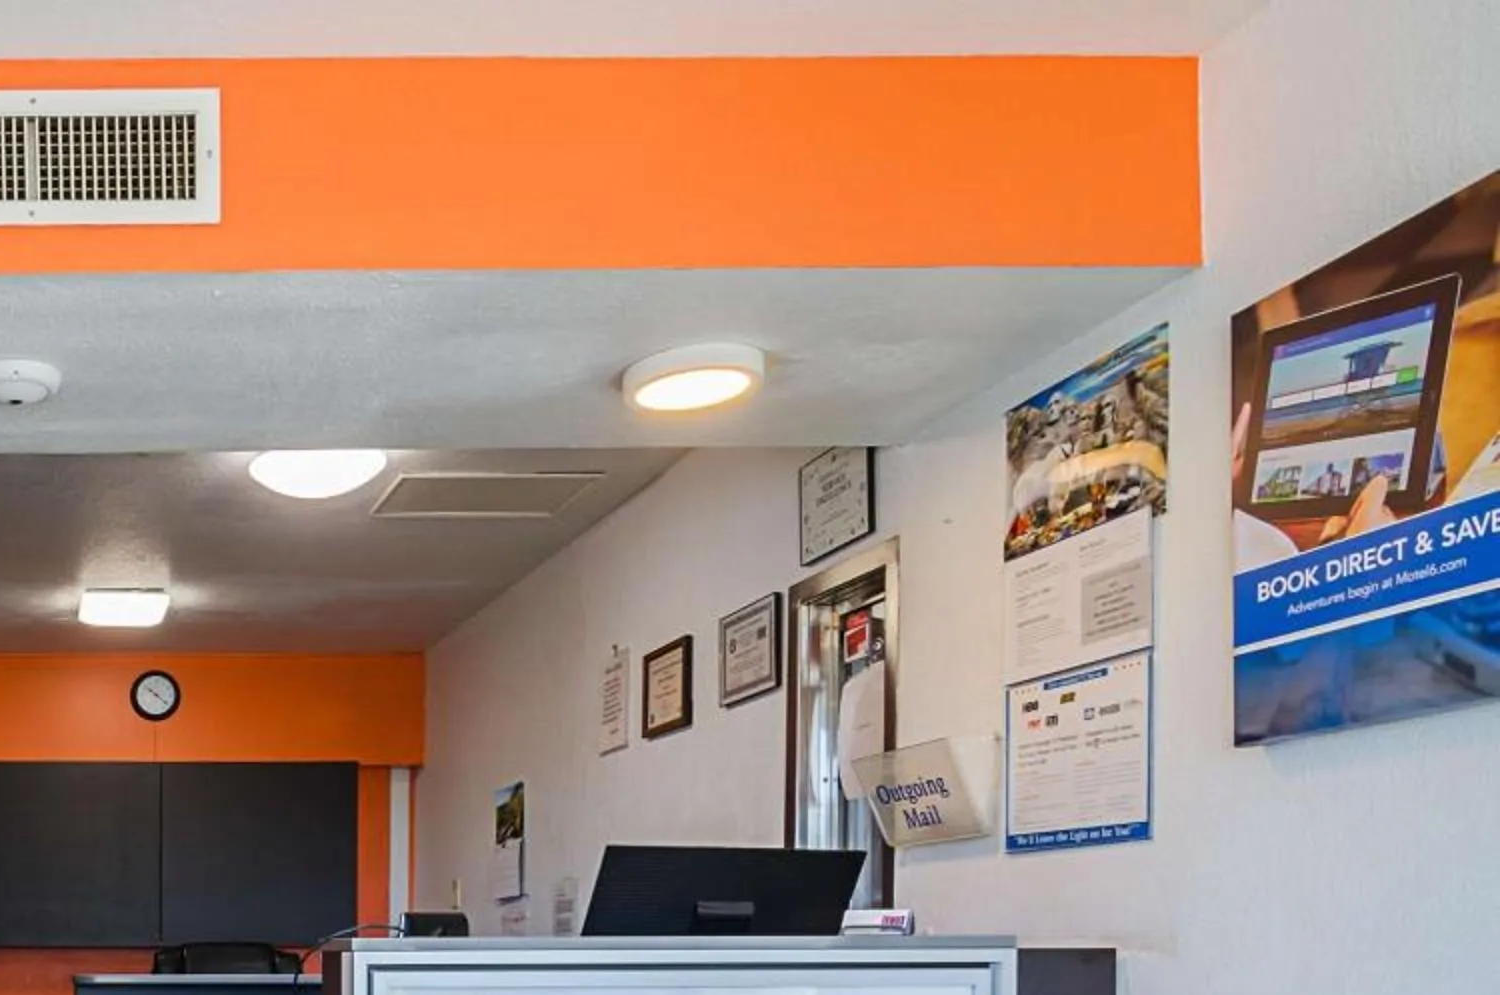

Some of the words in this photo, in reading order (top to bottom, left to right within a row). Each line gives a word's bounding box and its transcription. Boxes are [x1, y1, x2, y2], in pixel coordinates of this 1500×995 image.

[1257, 565, 1320, 603] BOOK
[1325, 537, 1408, 582] DIRECT
[1414, 531, 1434, 555] &
[1287, 592, 1347, 618] Adventures
[1347, 582, 1379, 600] begin
[1381, 577, 1393, 590] at
[1395, 557, 1468, 585] Motel6.com
[876, 776, 951, 804] Outgoing
[903, 804, 943, 829] Mail
